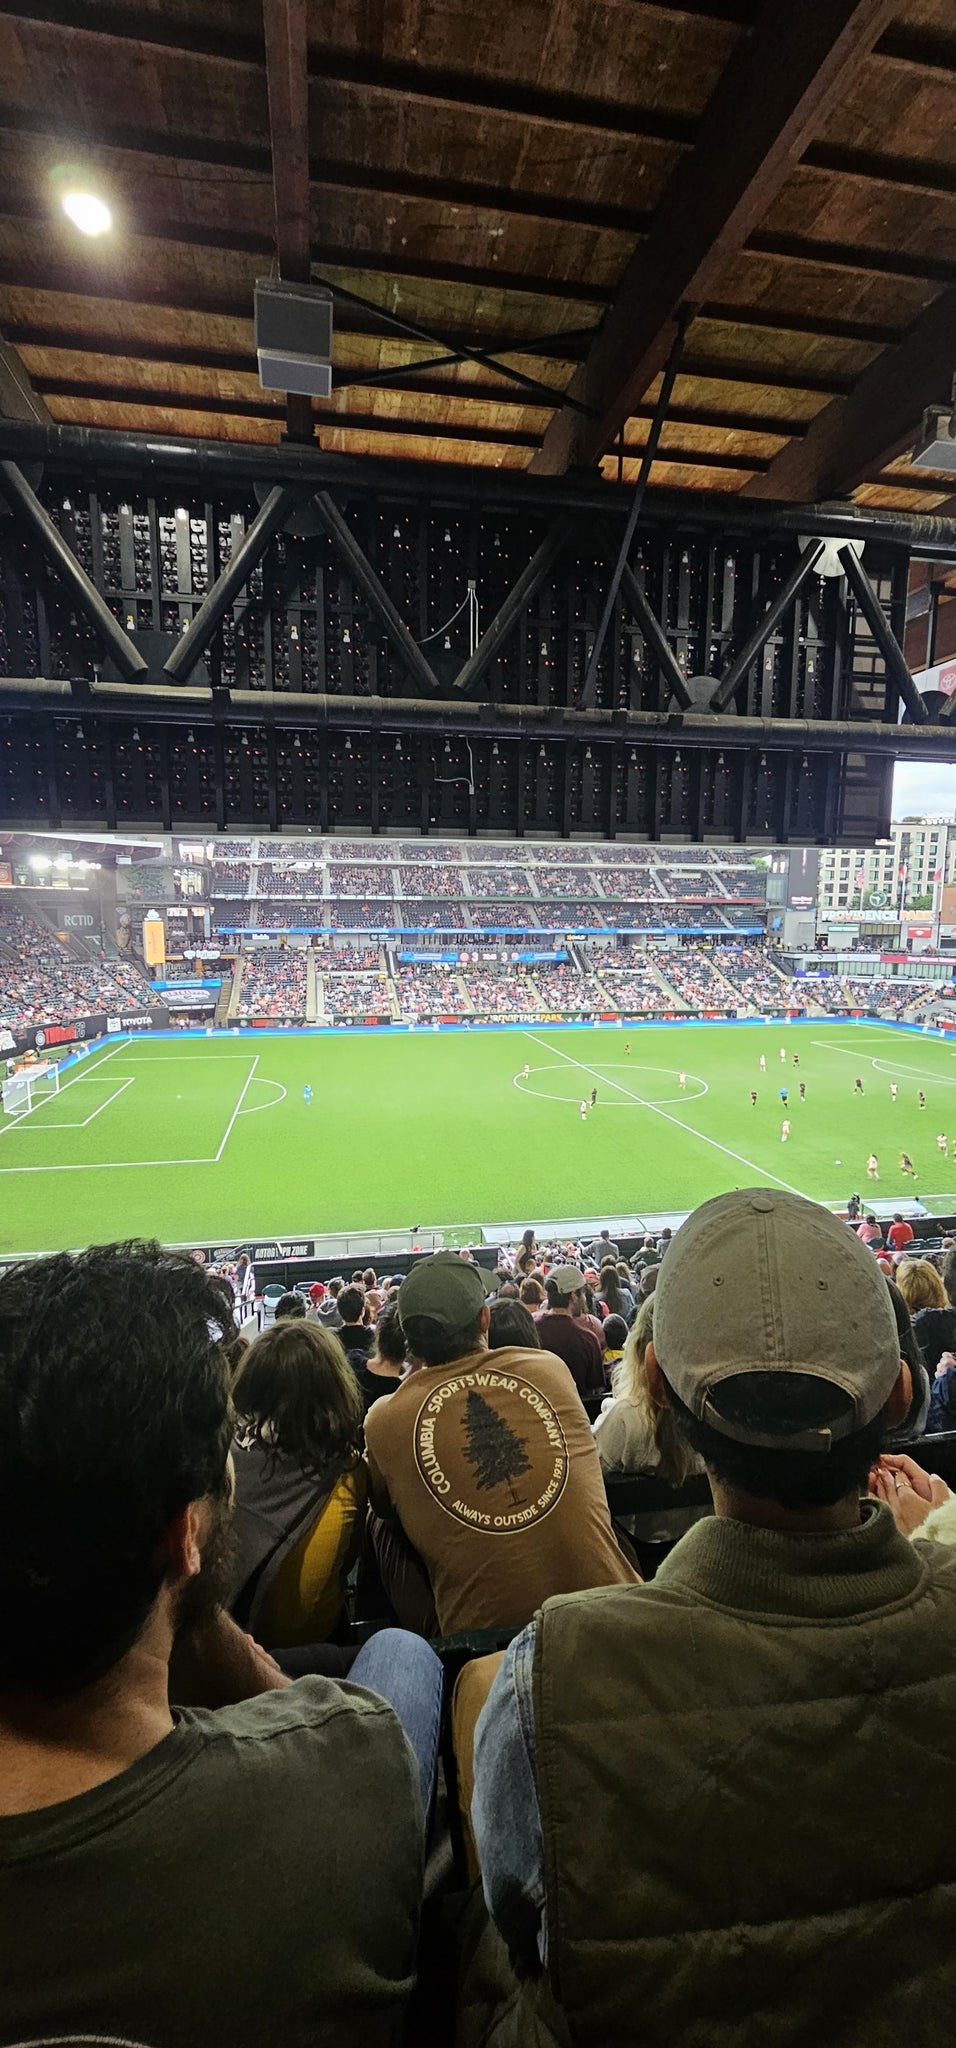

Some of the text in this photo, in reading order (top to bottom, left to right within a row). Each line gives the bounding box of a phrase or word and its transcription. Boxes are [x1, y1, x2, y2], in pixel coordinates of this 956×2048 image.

[64, 915, 94, 926] RCTID
[822, 910, 935, 921] PROVIDENCE PARK
[121, 1016, 152, 1027] TOYOTA
[291, 1245, 308, 1256] ZONE
[420, 1373, 563, 1494] COLUMBIA SPORTSWEAR COMPANY
[451, 1457, 563, 1527] ALWAYS OUTSIDE SINCE 1938
